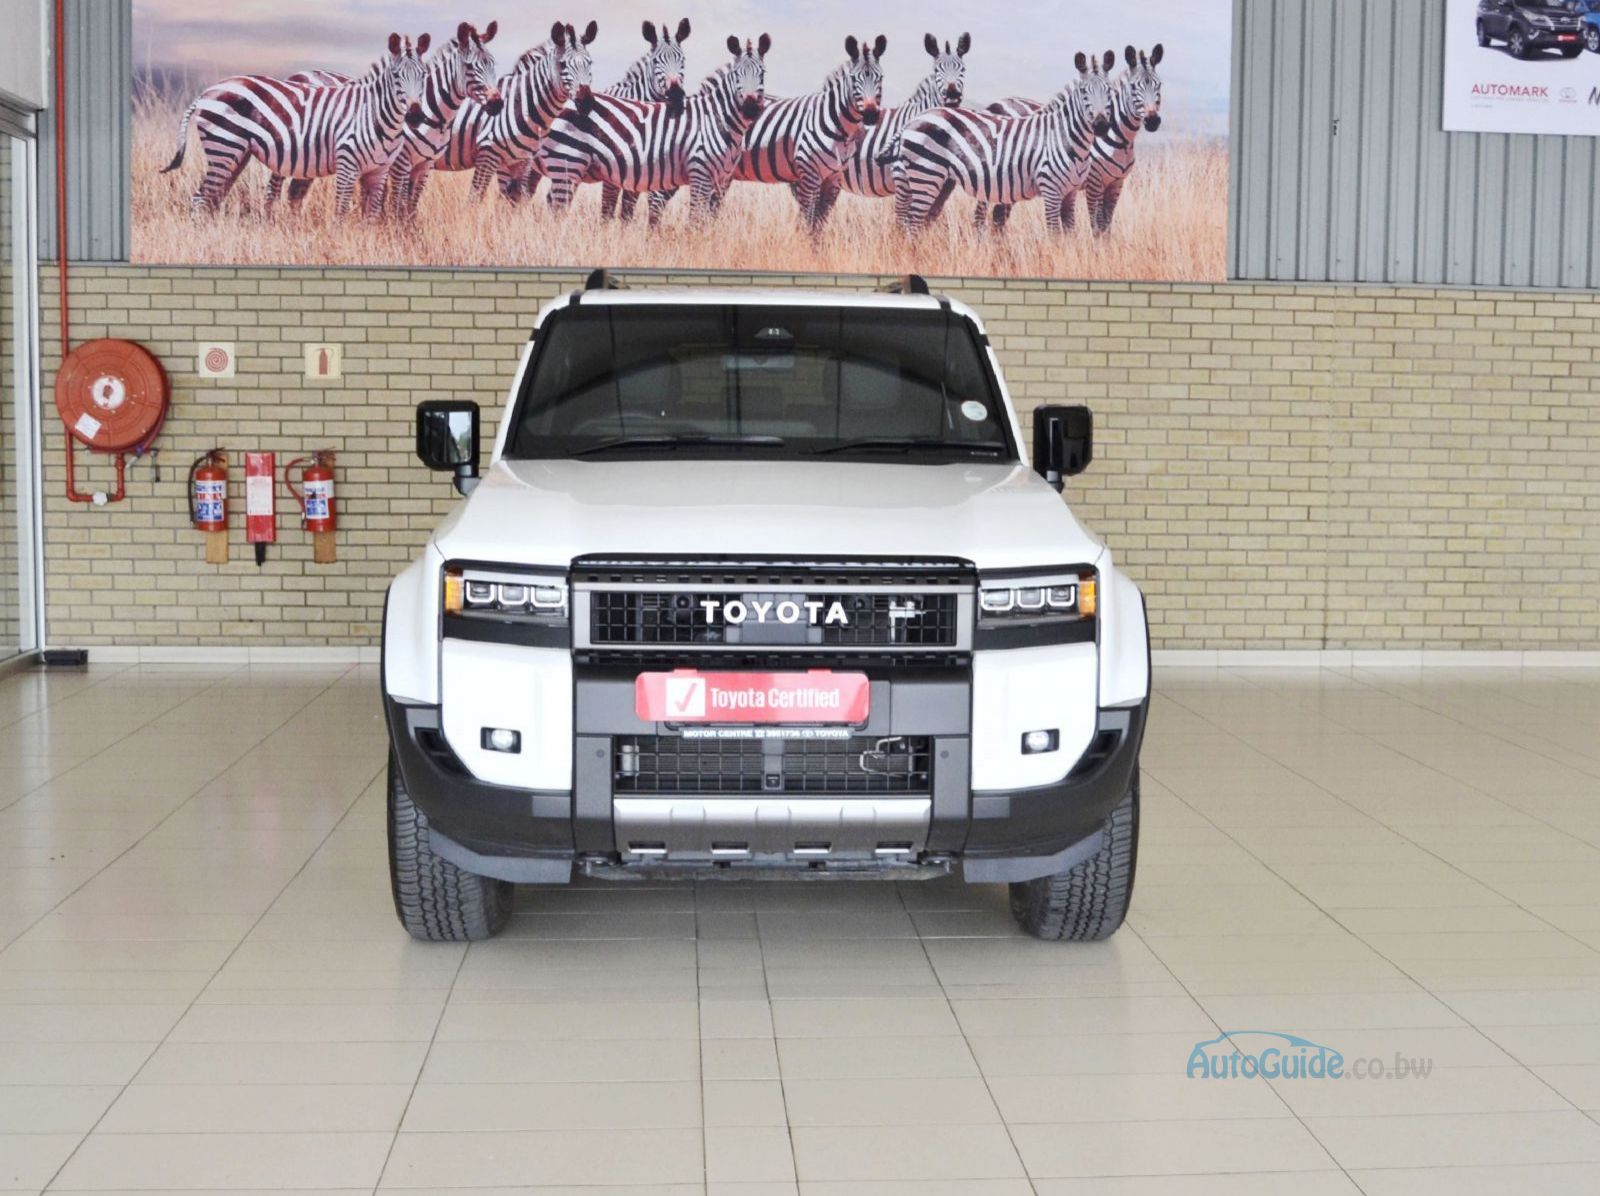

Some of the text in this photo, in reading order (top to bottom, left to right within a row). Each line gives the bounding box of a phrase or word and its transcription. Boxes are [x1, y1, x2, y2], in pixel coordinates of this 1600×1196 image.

[1471, 83, 1548, 97] AUTOMARK
[700, 600, 849, 625] TOYOTA
[710, 687, 841, 709] Toyota Certified
[683, 729, 717, 738] MOTOR
[717, 729, 754, 738] CENTRE
[814, 729, 849, 738] TOYOTA
